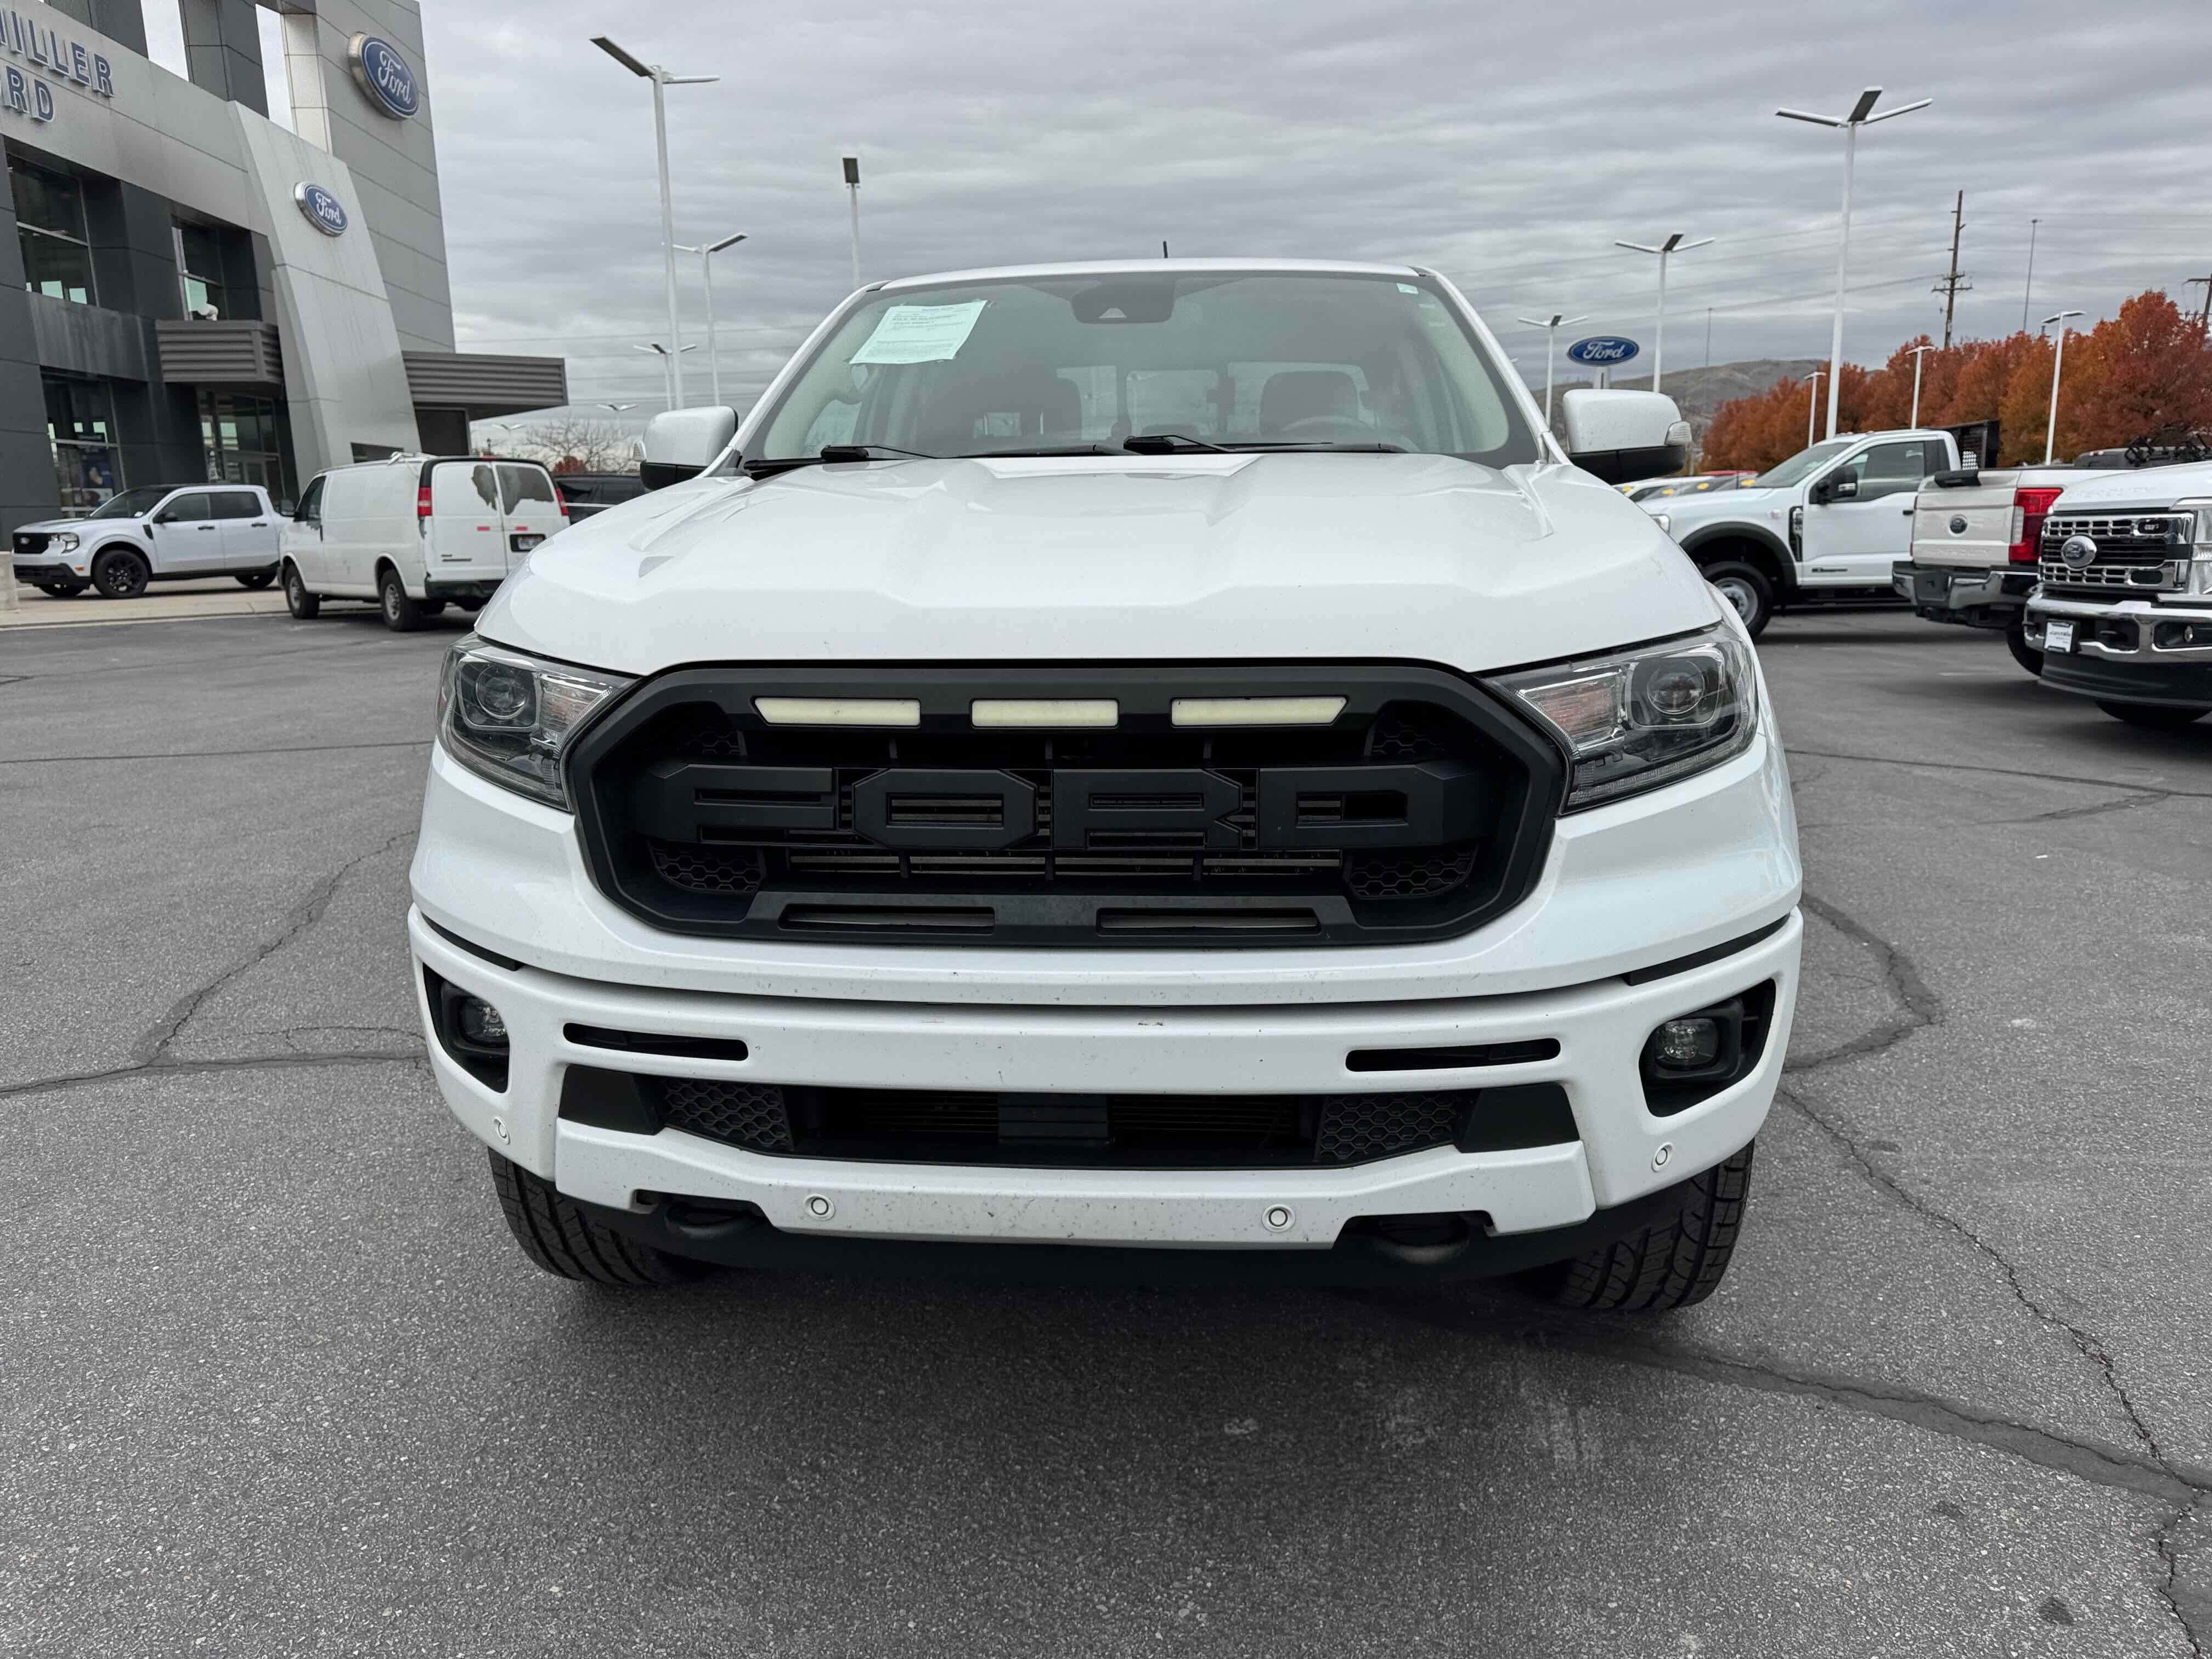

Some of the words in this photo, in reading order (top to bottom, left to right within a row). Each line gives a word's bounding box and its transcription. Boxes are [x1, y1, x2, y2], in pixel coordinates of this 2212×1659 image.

[0, 65, 55, 123] RD
[377, 50, 412, 105] Ford
[315, 192, 342, 224] Ford
[1582, 341, 1626, 359] Ford
[650, 764, 1476, 851] FORD
